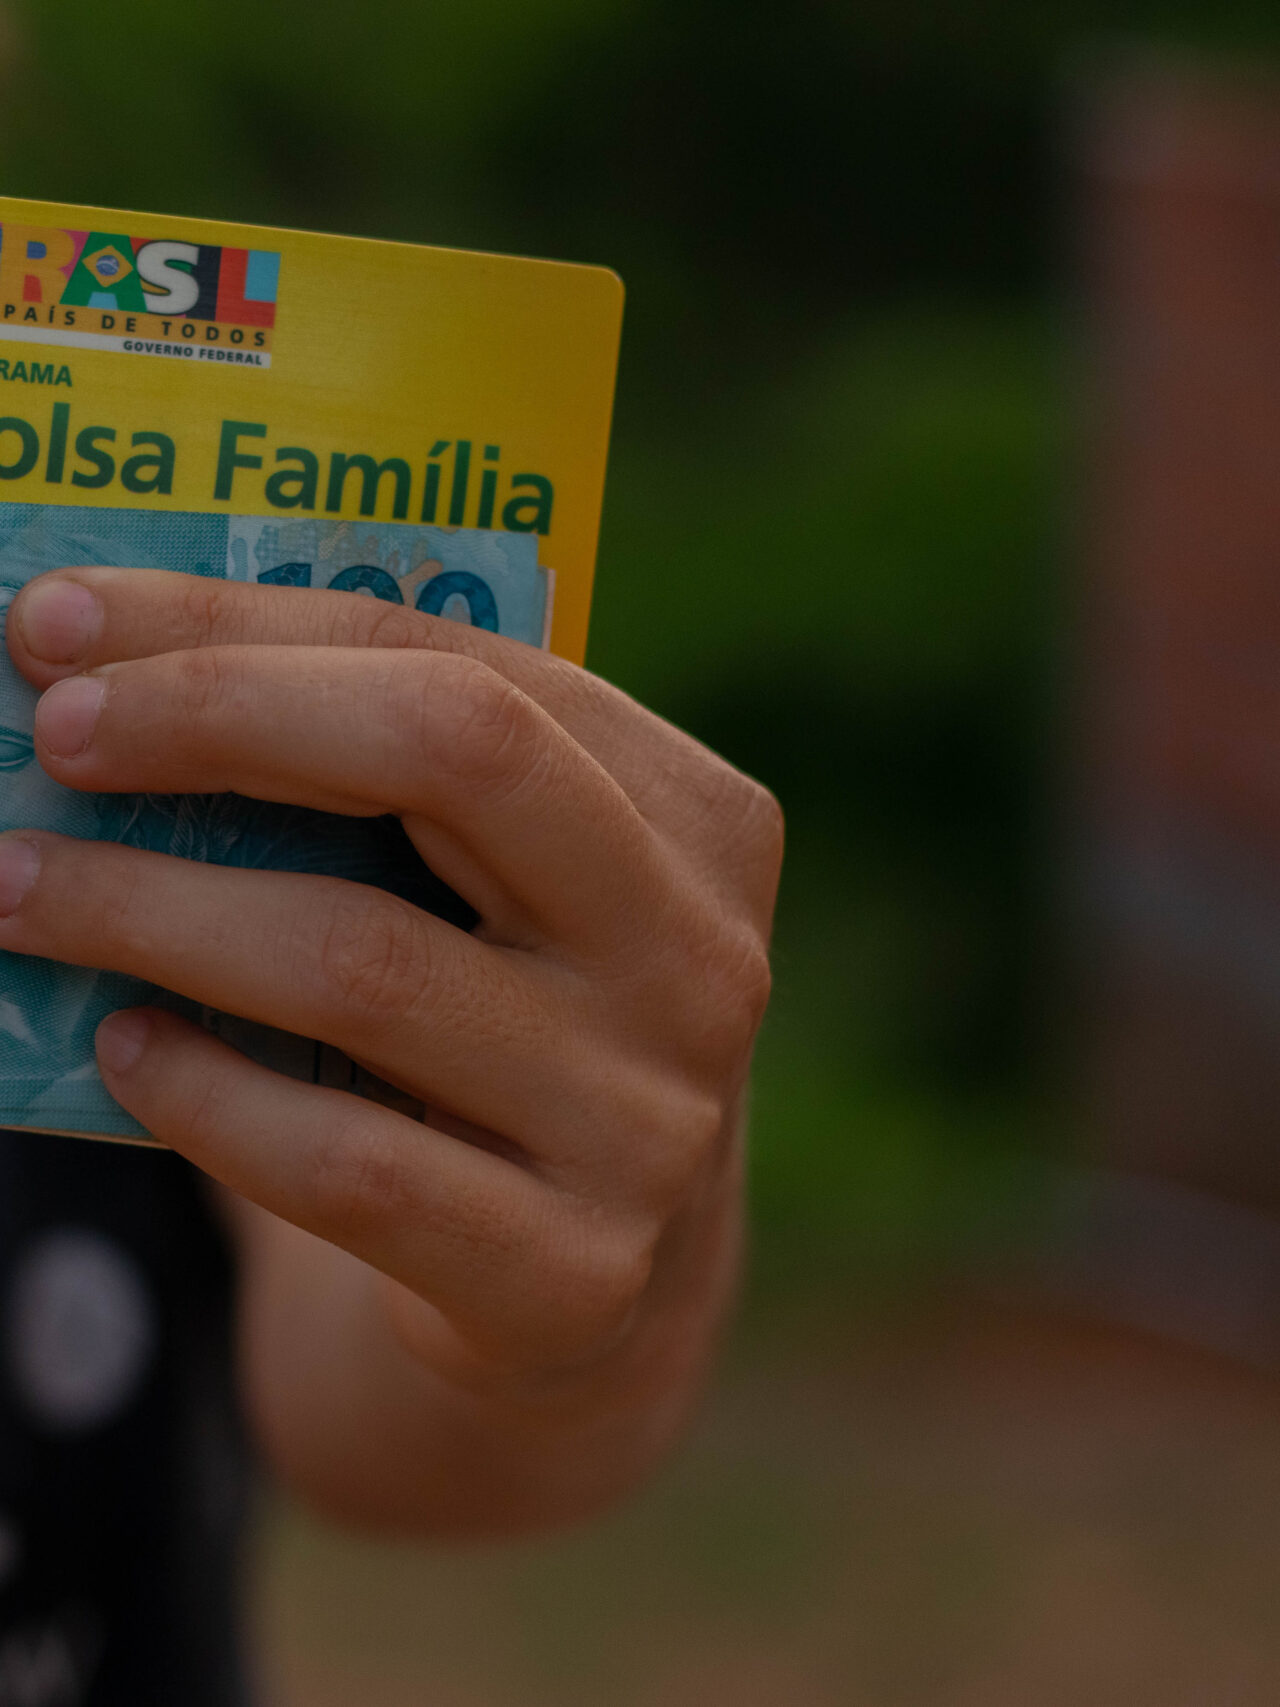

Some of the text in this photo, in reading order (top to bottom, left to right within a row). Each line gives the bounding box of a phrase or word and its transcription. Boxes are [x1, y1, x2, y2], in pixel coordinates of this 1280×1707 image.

[4, 305, 76, 326] PAÍS
[101, 315, 136, 333] DE
[162, 322, 266, 347] TODOS
[123, 340, 262, 366] GOVERNO FEDERAL
[213, 421, 554, 536] Família
